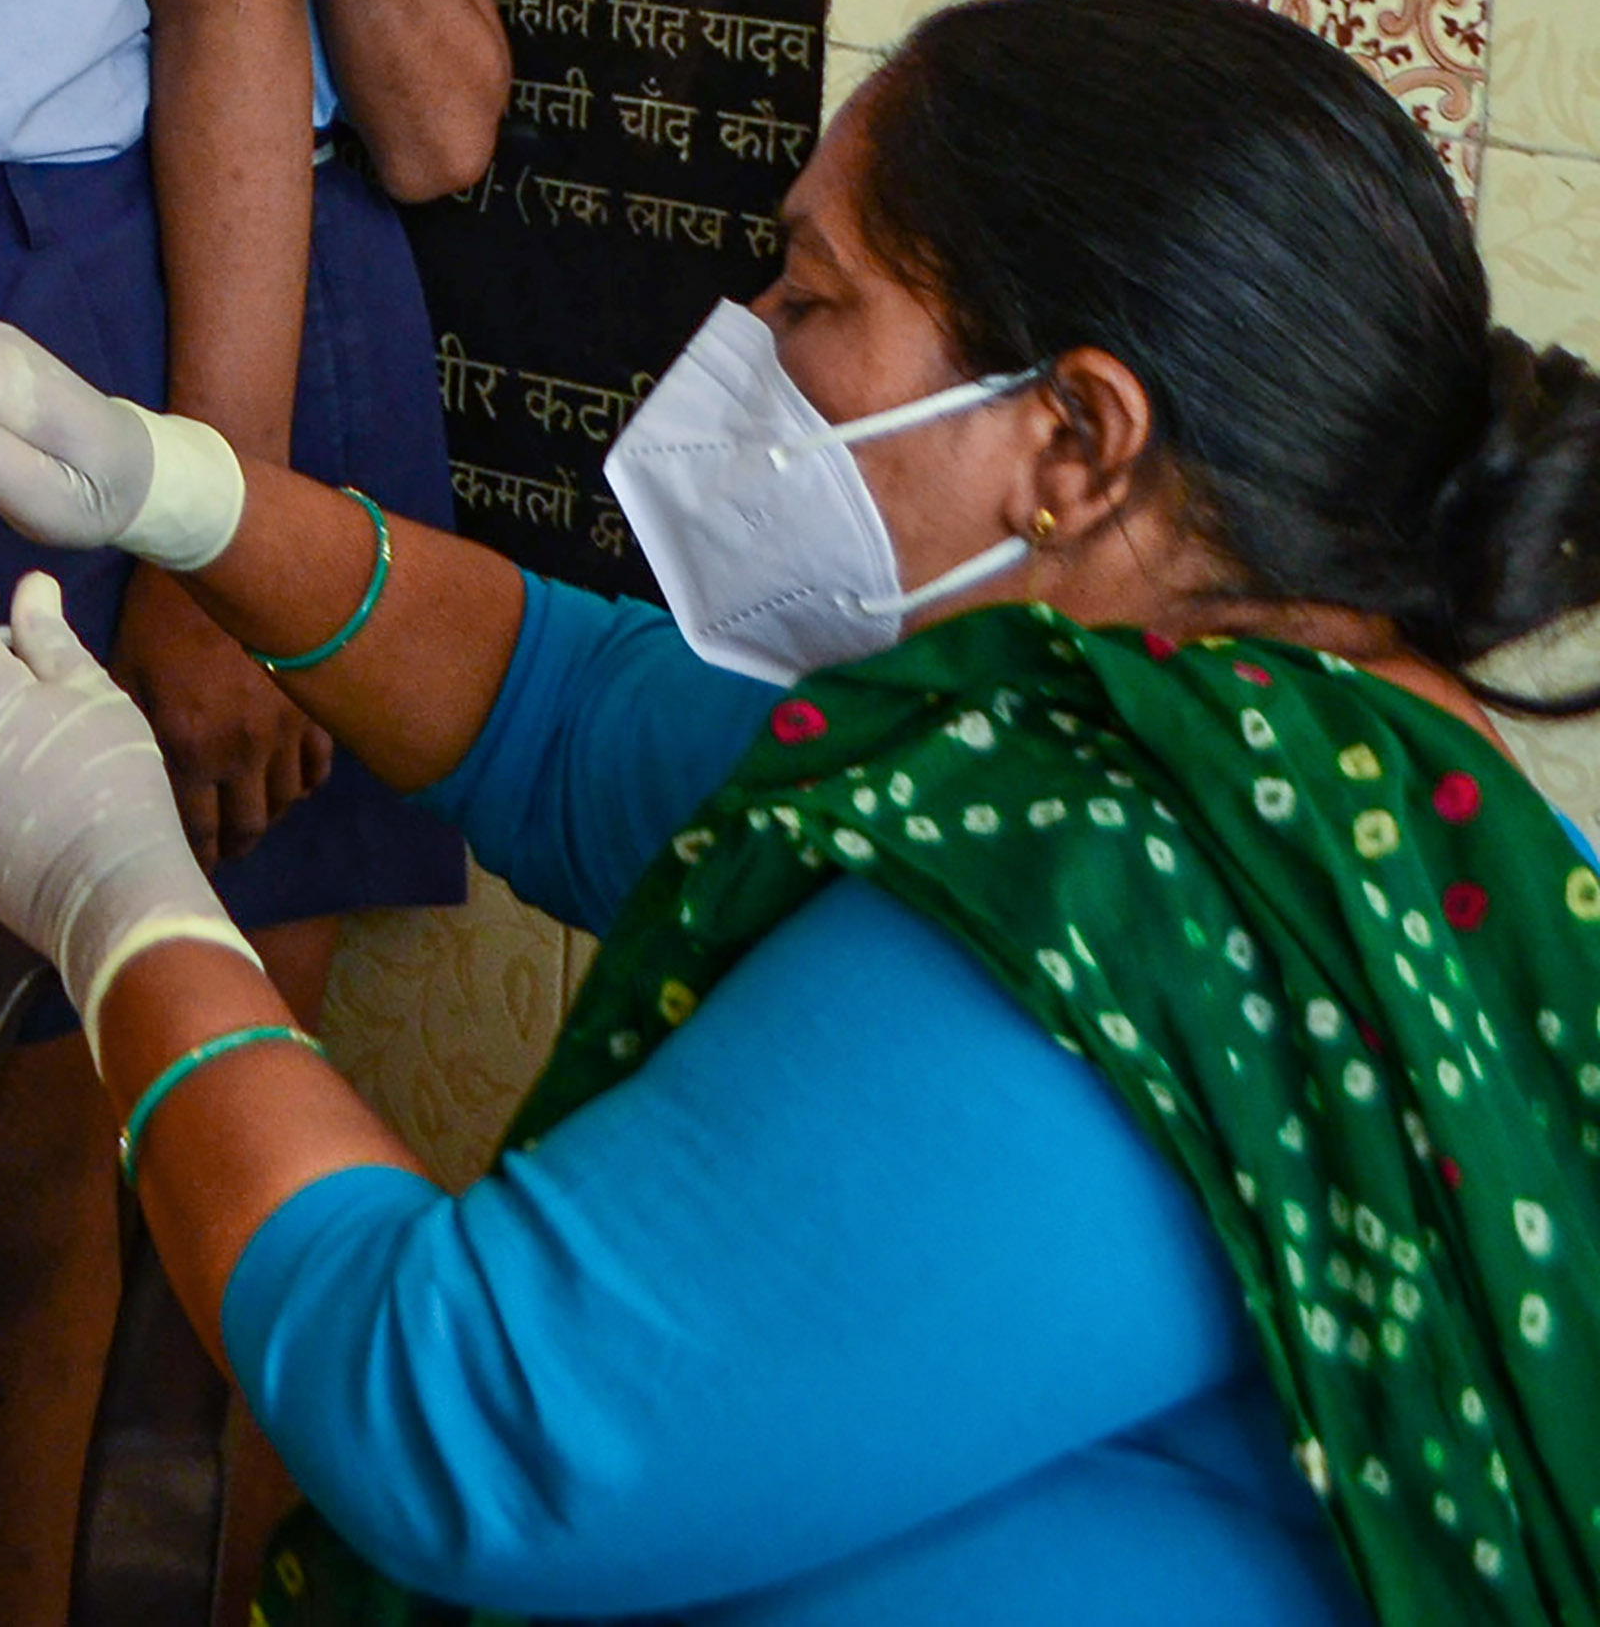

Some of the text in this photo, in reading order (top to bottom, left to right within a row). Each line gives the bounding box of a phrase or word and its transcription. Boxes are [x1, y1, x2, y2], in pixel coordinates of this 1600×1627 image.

[700, 8, 818, 78] यादव
[716, 98, 812, 170] कौर
[623, 191, 730, 251] लाख
